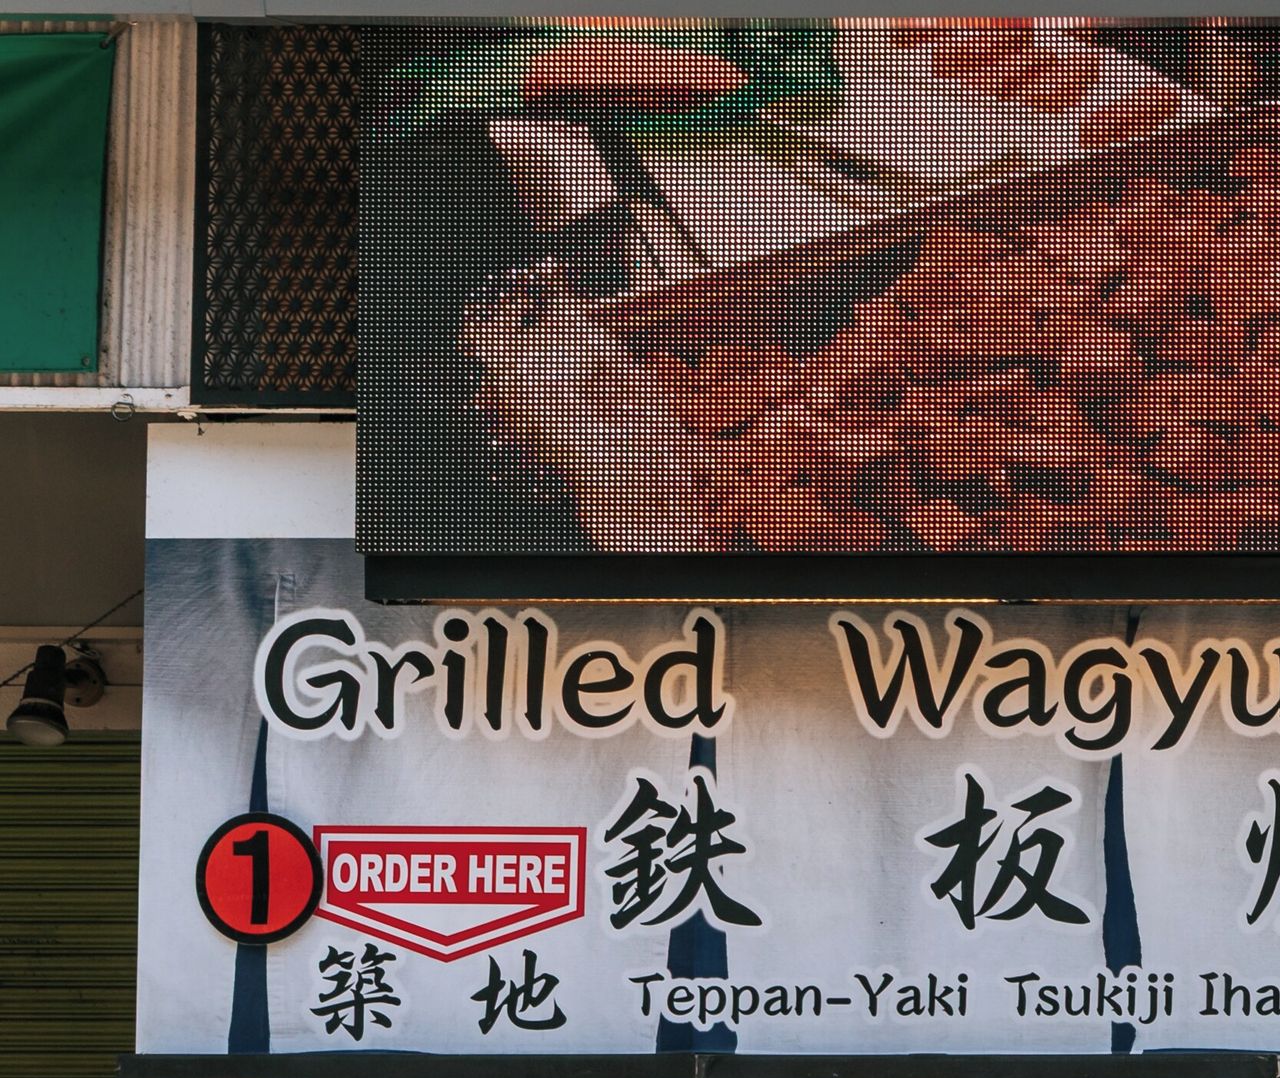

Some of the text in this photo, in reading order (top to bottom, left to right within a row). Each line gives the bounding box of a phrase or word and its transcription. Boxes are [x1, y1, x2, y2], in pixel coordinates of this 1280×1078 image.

[265, 617, 728, 732] Grilled
[233, 830, 270, 925] 1
[332, 852, 566, 894] ORDER HERE
[629, 973, 969, 1024] Teppan-Yaki
[1003, 970, 1175, 1024] Tsukiji
